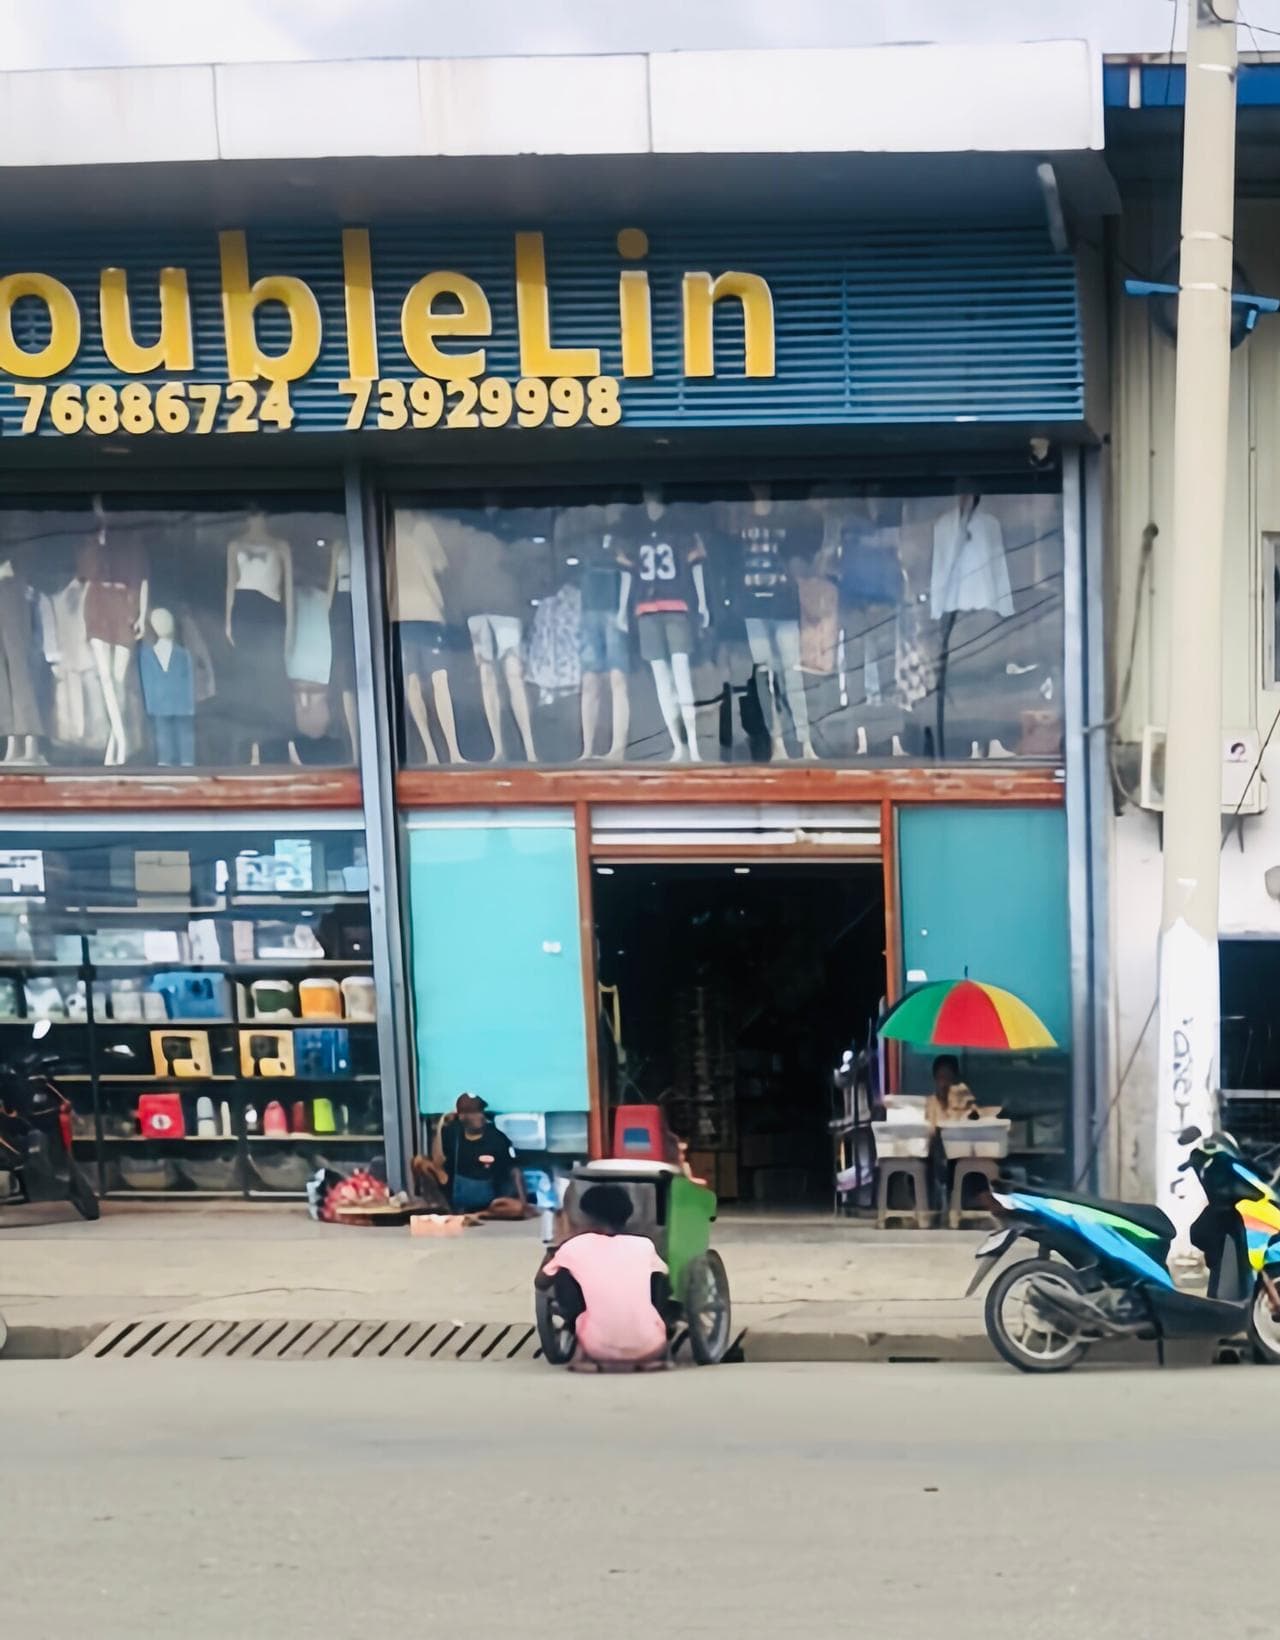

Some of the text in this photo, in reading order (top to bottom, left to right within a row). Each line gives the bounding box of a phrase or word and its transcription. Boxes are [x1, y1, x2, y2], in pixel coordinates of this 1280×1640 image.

[13, 376, 623, 435] 76886724 73929998
[640, 543, 677, 581] 33
